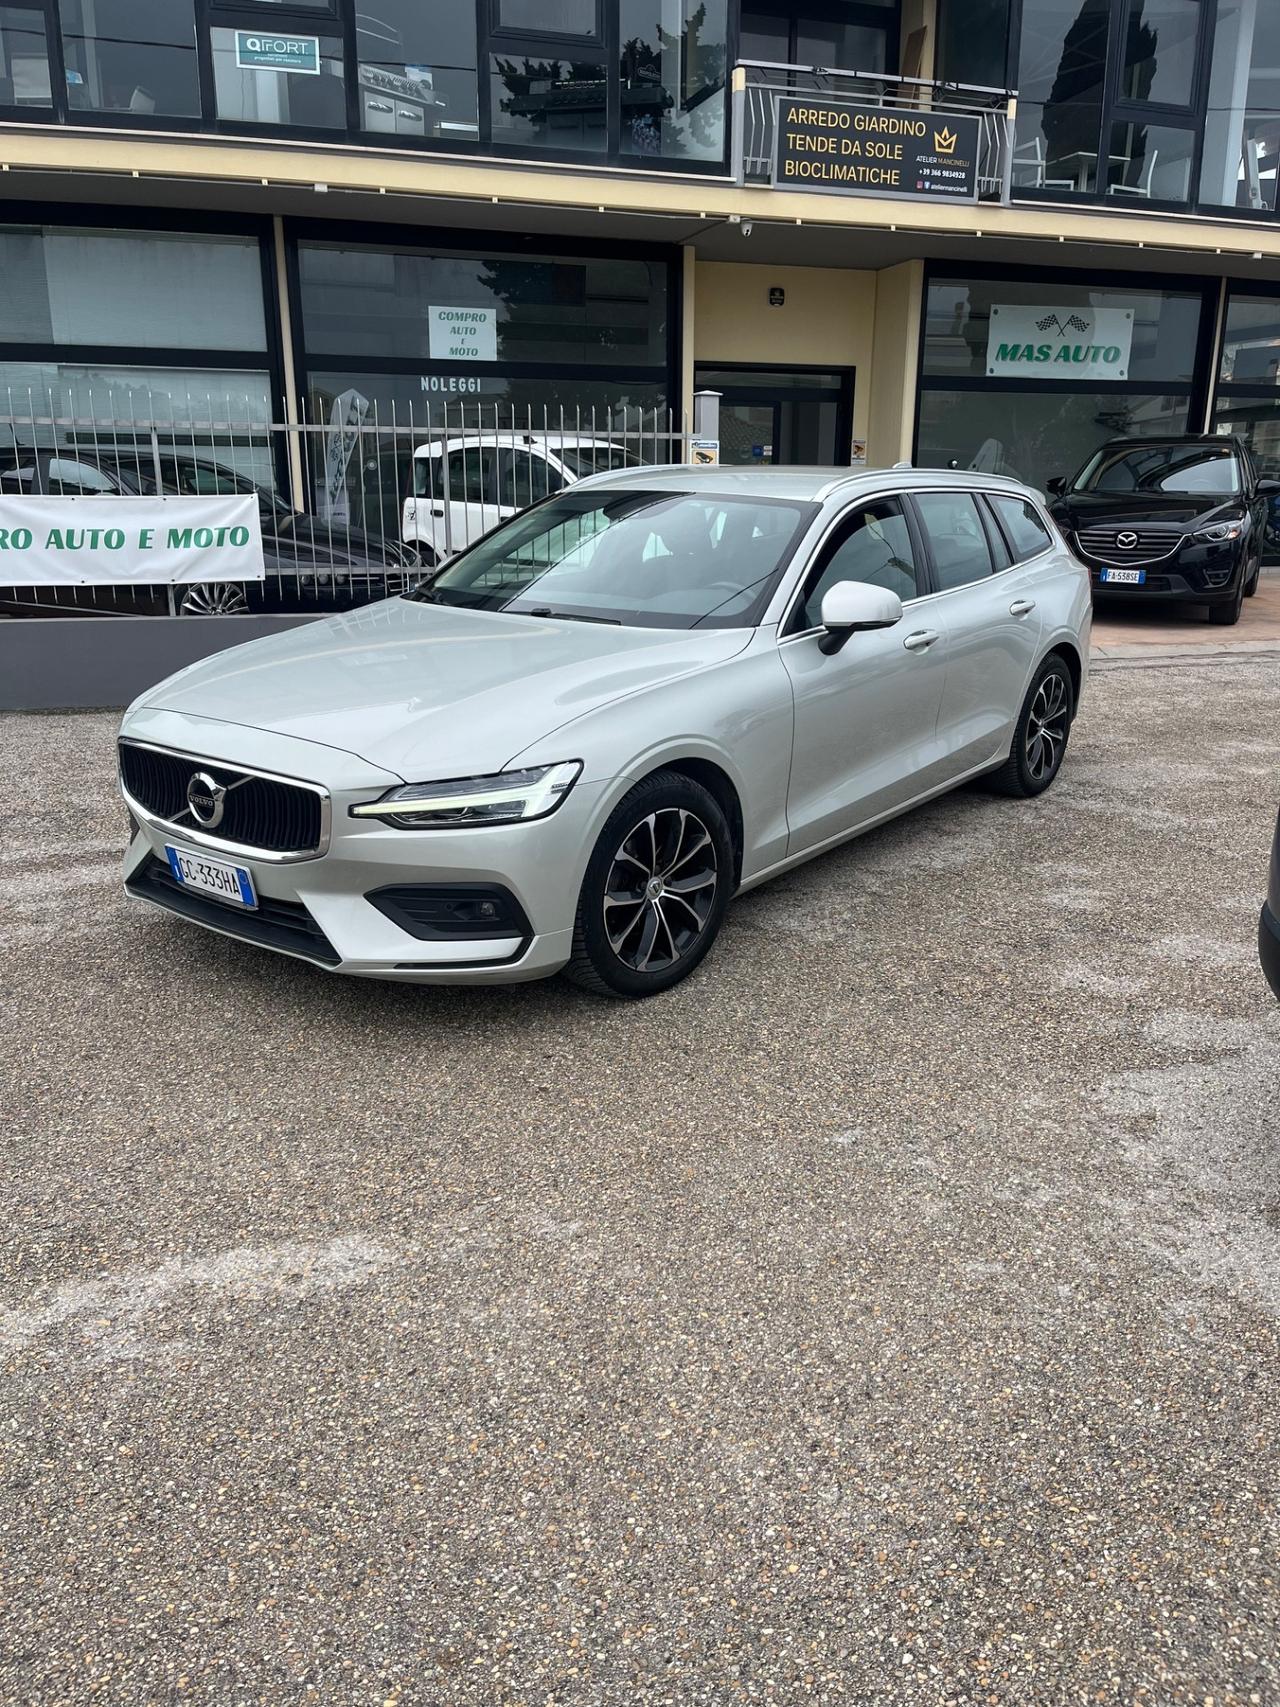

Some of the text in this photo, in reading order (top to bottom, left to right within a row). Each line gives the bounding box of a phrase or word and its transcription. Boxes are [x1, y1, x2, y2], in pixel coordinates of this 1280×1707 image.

[787, 107, 926, 137] ARREDO GIARDINO
[786, 133, 904, 160] TENDE DA SOLE
[915, 155, 970, 168] ATELIER MANCINELLI
[785, 159, 900, 185] BIOCLIMATICHE
[438, 311, 487, 323] COMPRO
[450, 326, 477, 336] AUTO
[448, 347, 479, 357] MOTO
[995, 343, 1121, 364] MAS AUTO
[421, 376, 481, 393] NOLEGGI
[45, 529, 126, 550] AUTO
[138, 528, 155, 550] E
[167, 526, 250, 549] MOTO
[190, 794, 214, 808] VOLVO
